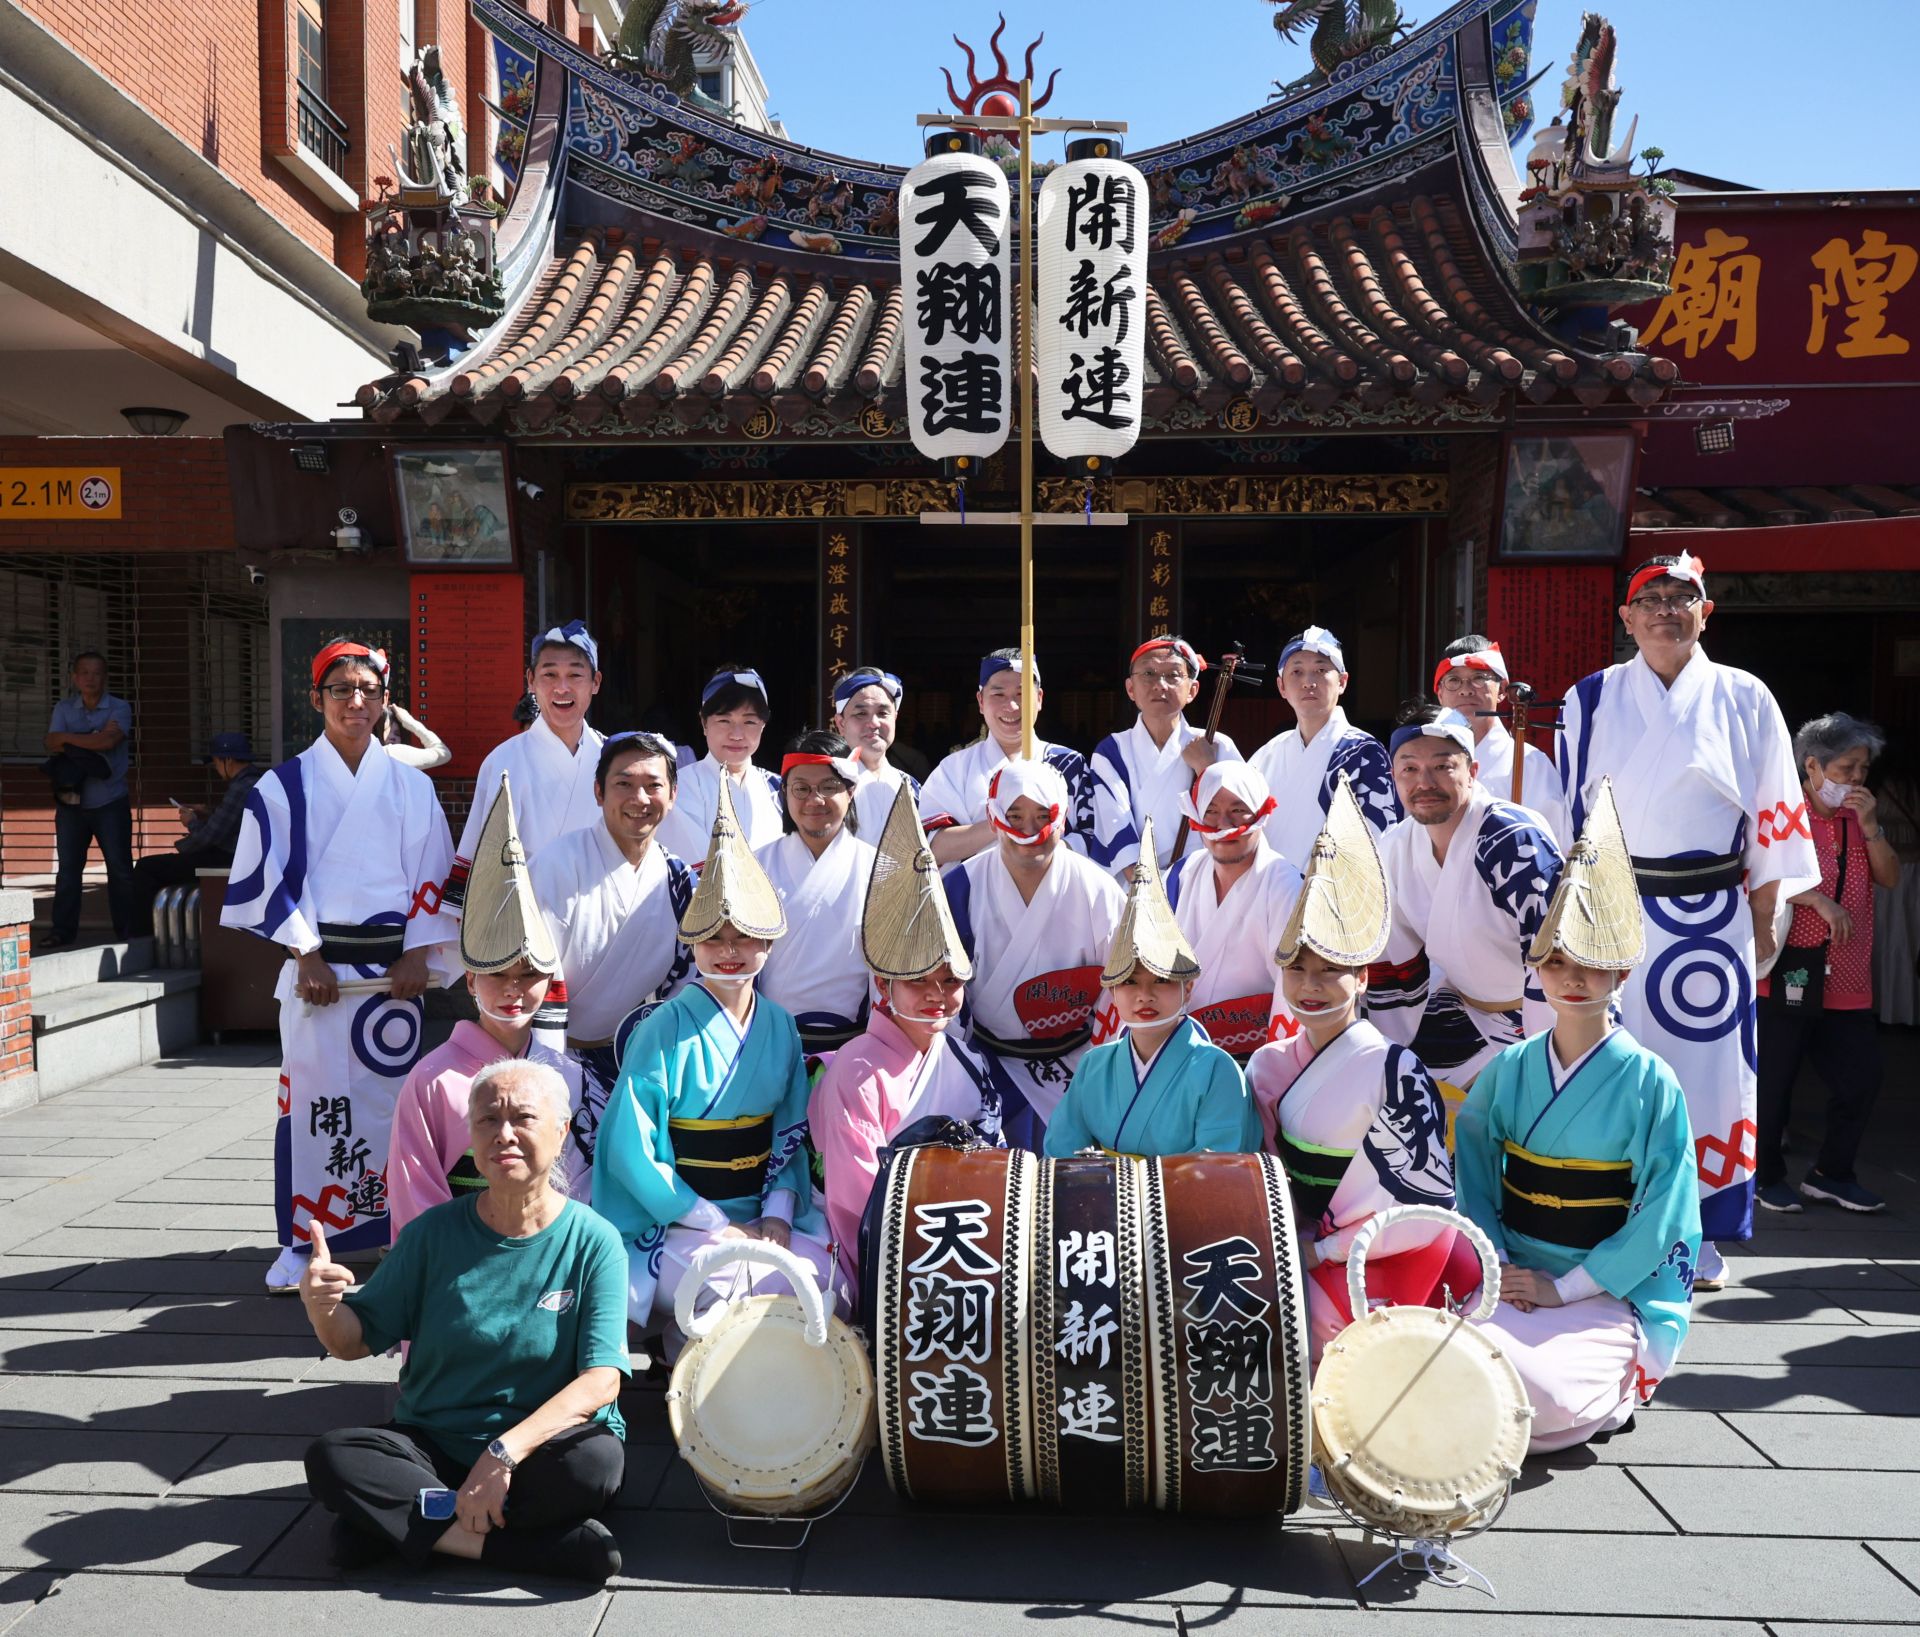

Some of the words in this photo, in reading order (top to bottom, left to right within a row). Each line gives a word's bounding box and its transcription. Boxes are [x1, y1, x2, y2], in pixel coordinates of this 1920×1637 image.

[914, 170, 1001, 436] 天翔連
[1059, 172, 1136, 430] 開新連
[309, 1096, 389, 1218] 開新連
[906, 1199, 1001, 1447] 天翔連
[1054, 1230, 1123, 1443] 開新連
[1182, 1236, 1278, 1473] 天翔連
